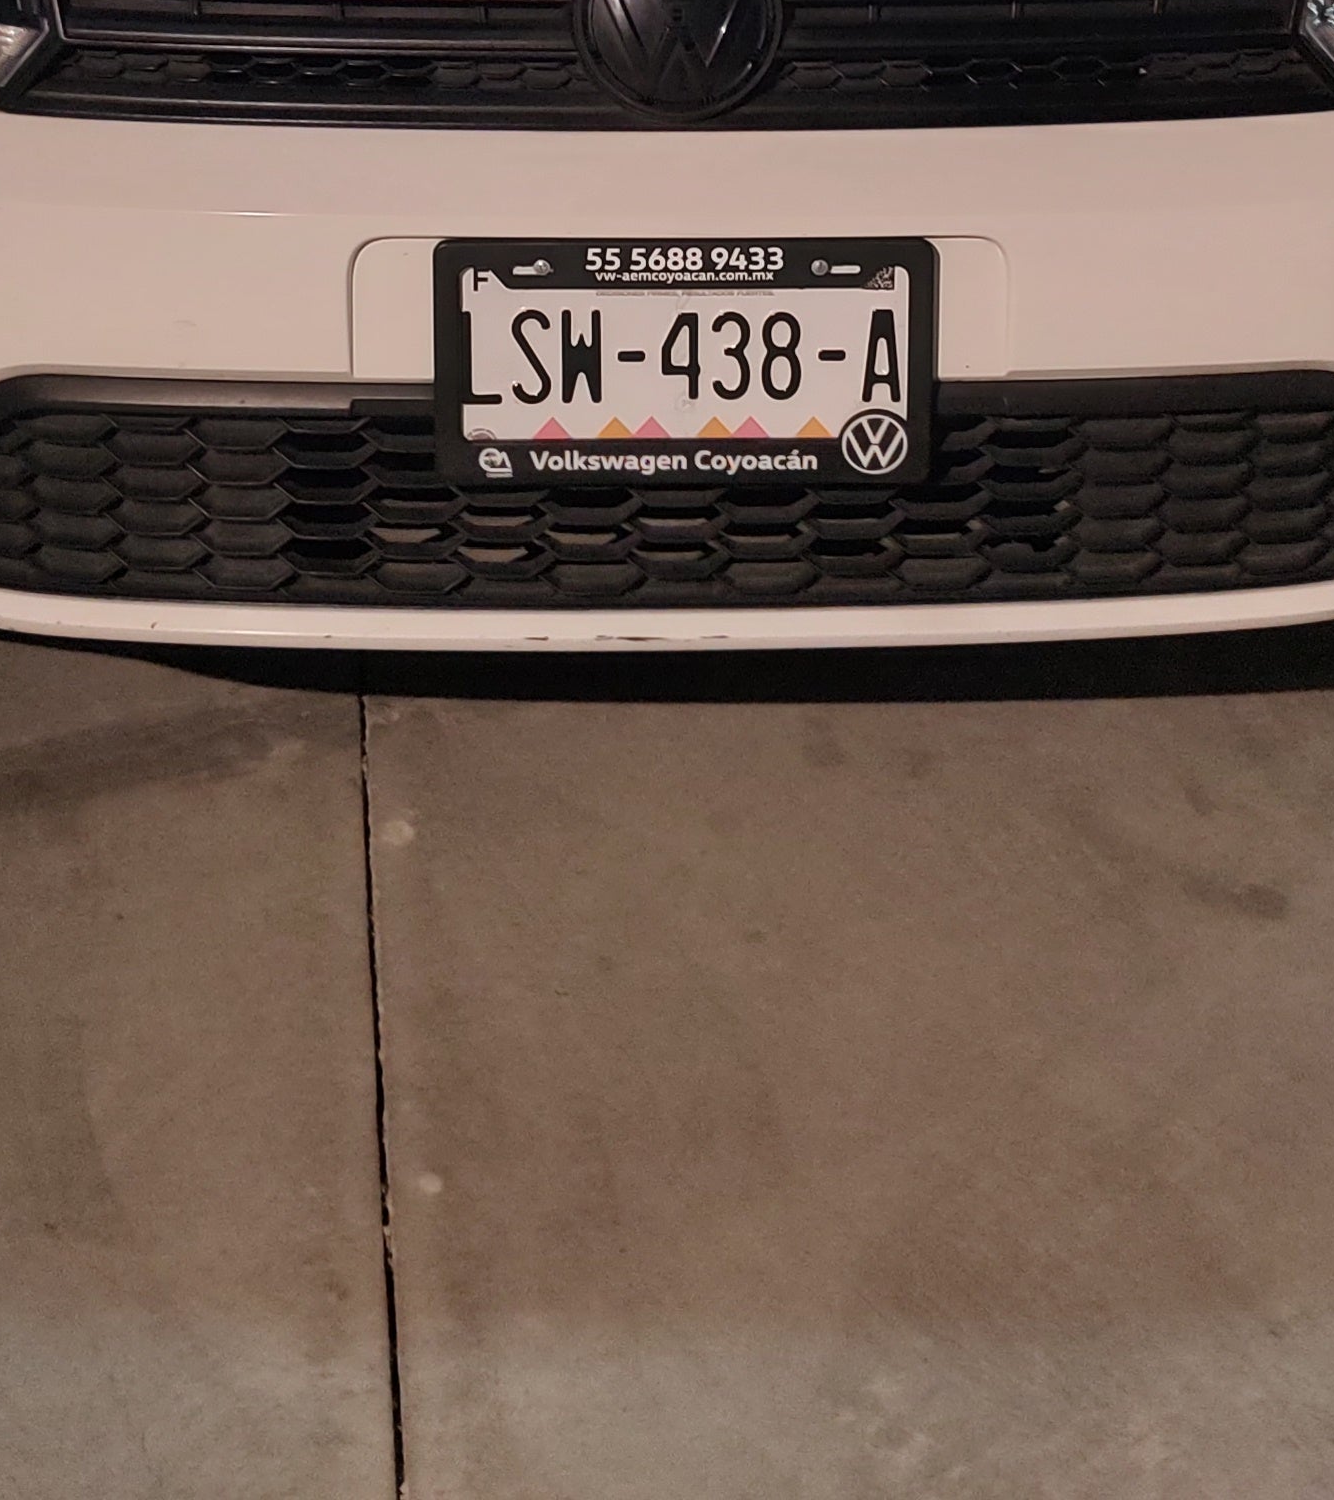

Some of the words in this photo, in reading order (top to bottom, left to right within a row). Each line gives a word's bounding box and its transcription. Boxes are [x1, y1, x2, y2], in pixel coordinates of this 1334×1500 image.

[584, 247, 621, 271] 55
[629, 246, 703, 271] 5688
[710, 246, 784, 271] 9433
[594, 271, 774, 284] vw-aemcoyoacan.com.mx
[462, 309, 901, 403] LSW-438-A
[529, 449, 688, 476] Volkswagen
[694, 448, 818, 476] Coyoacán
